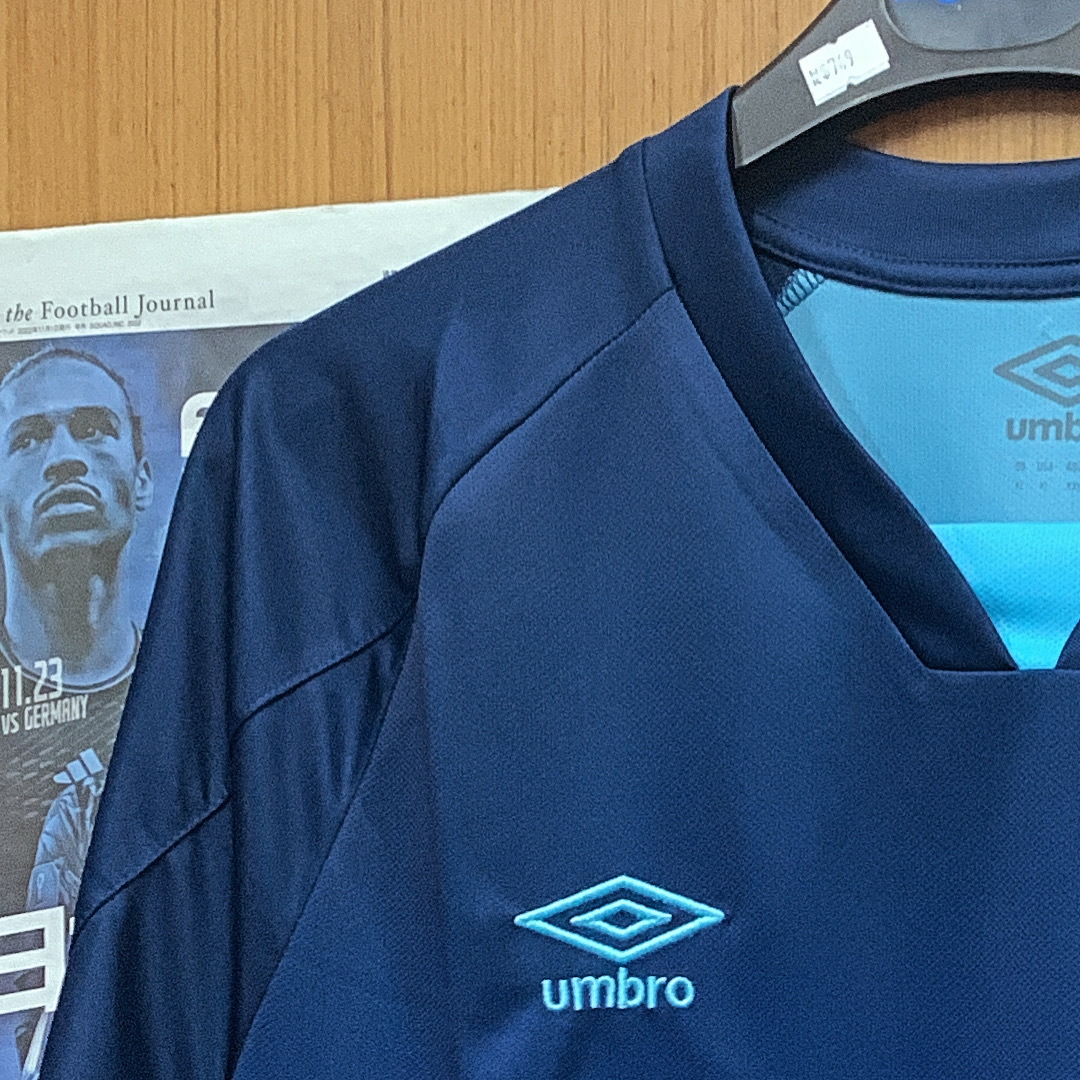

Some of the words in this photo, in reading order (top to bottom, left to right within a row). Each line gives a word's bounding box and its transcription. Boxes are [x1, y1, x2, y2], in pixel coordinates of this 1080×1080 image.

[5, 302, 34, 323] the
[41, 295, 129, 320] Football
[133, 290, 216, 318] Journal
[1, 657, 64, 709] 11.23
[24, 695, 89, 730] GERMANY
[541, 967, 696, 1011] umbro
